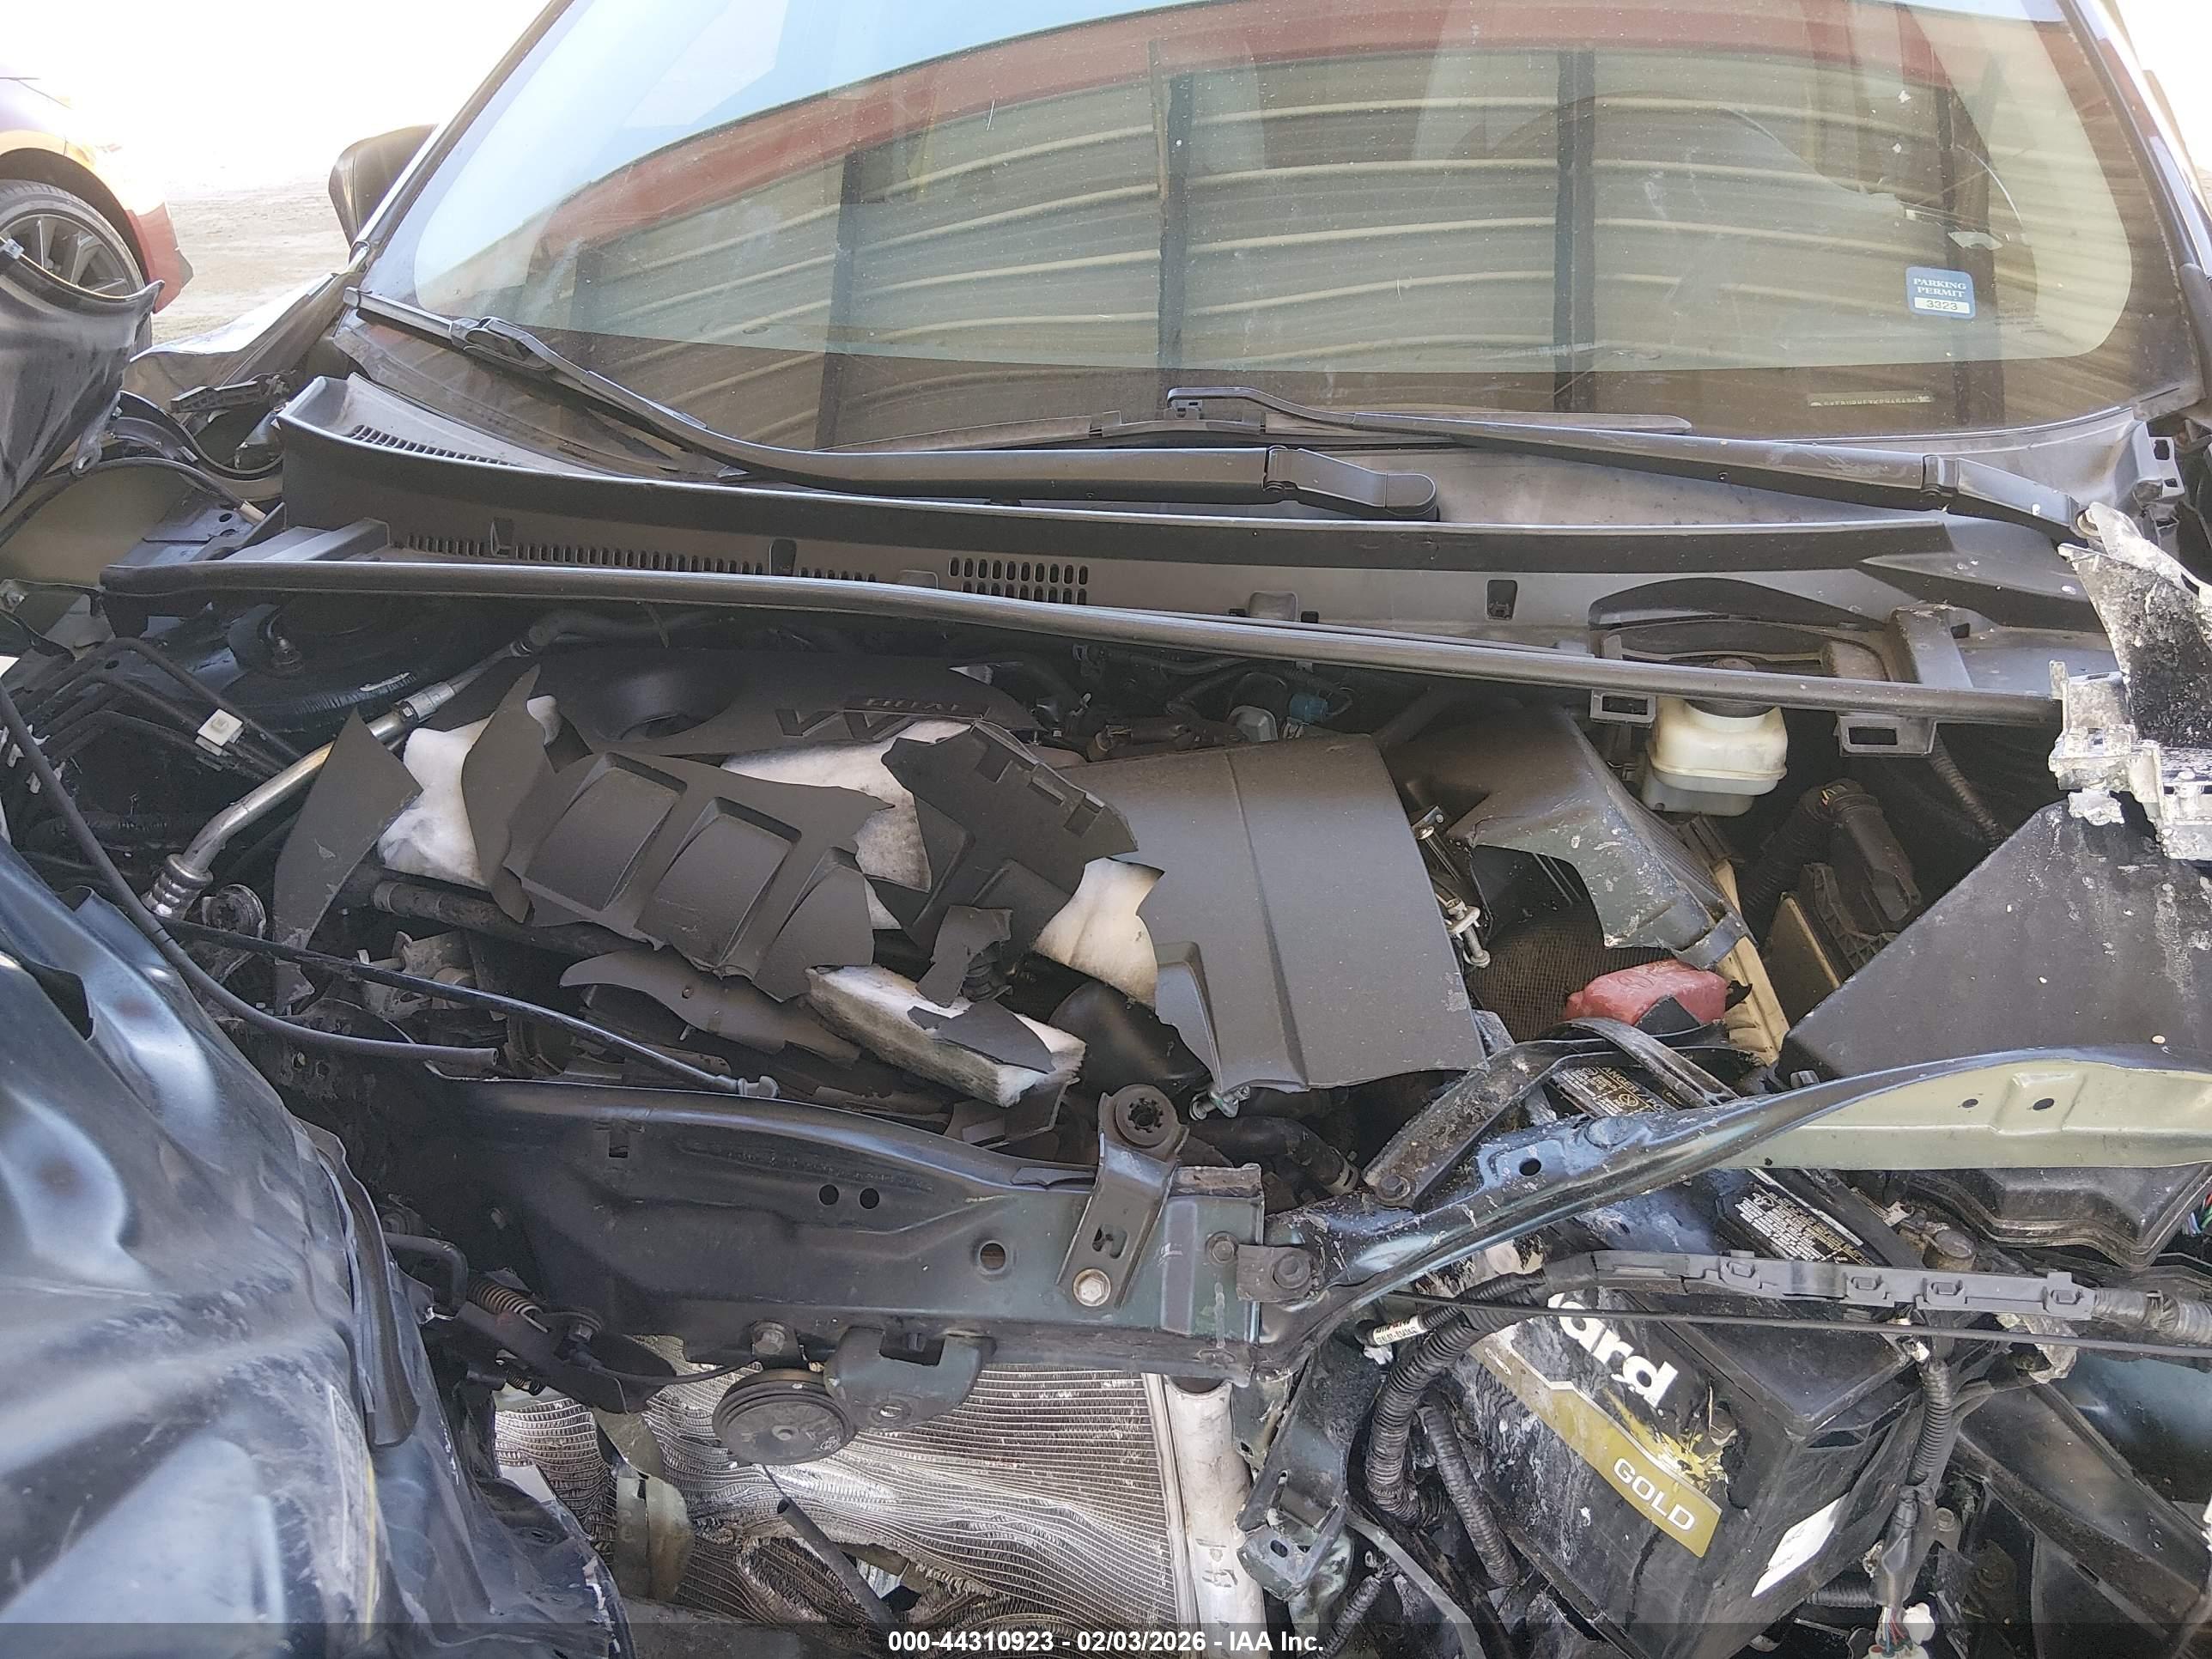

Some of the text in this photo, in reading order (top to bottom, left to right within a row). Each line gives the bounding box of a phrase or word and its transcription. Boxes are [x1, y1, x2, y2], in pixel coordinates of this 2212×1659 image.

[1913, 277, 1966, 290] PARKING
[1917, 286, 1966, 298] PERMIT
[1926, 300, 1958, 311] 3323
[1601, 1064, 1640, 1093] ANGER
[1547, 1292, 1679, 1408] ard
[1613, 1458, 1696, 1531] GOLD
